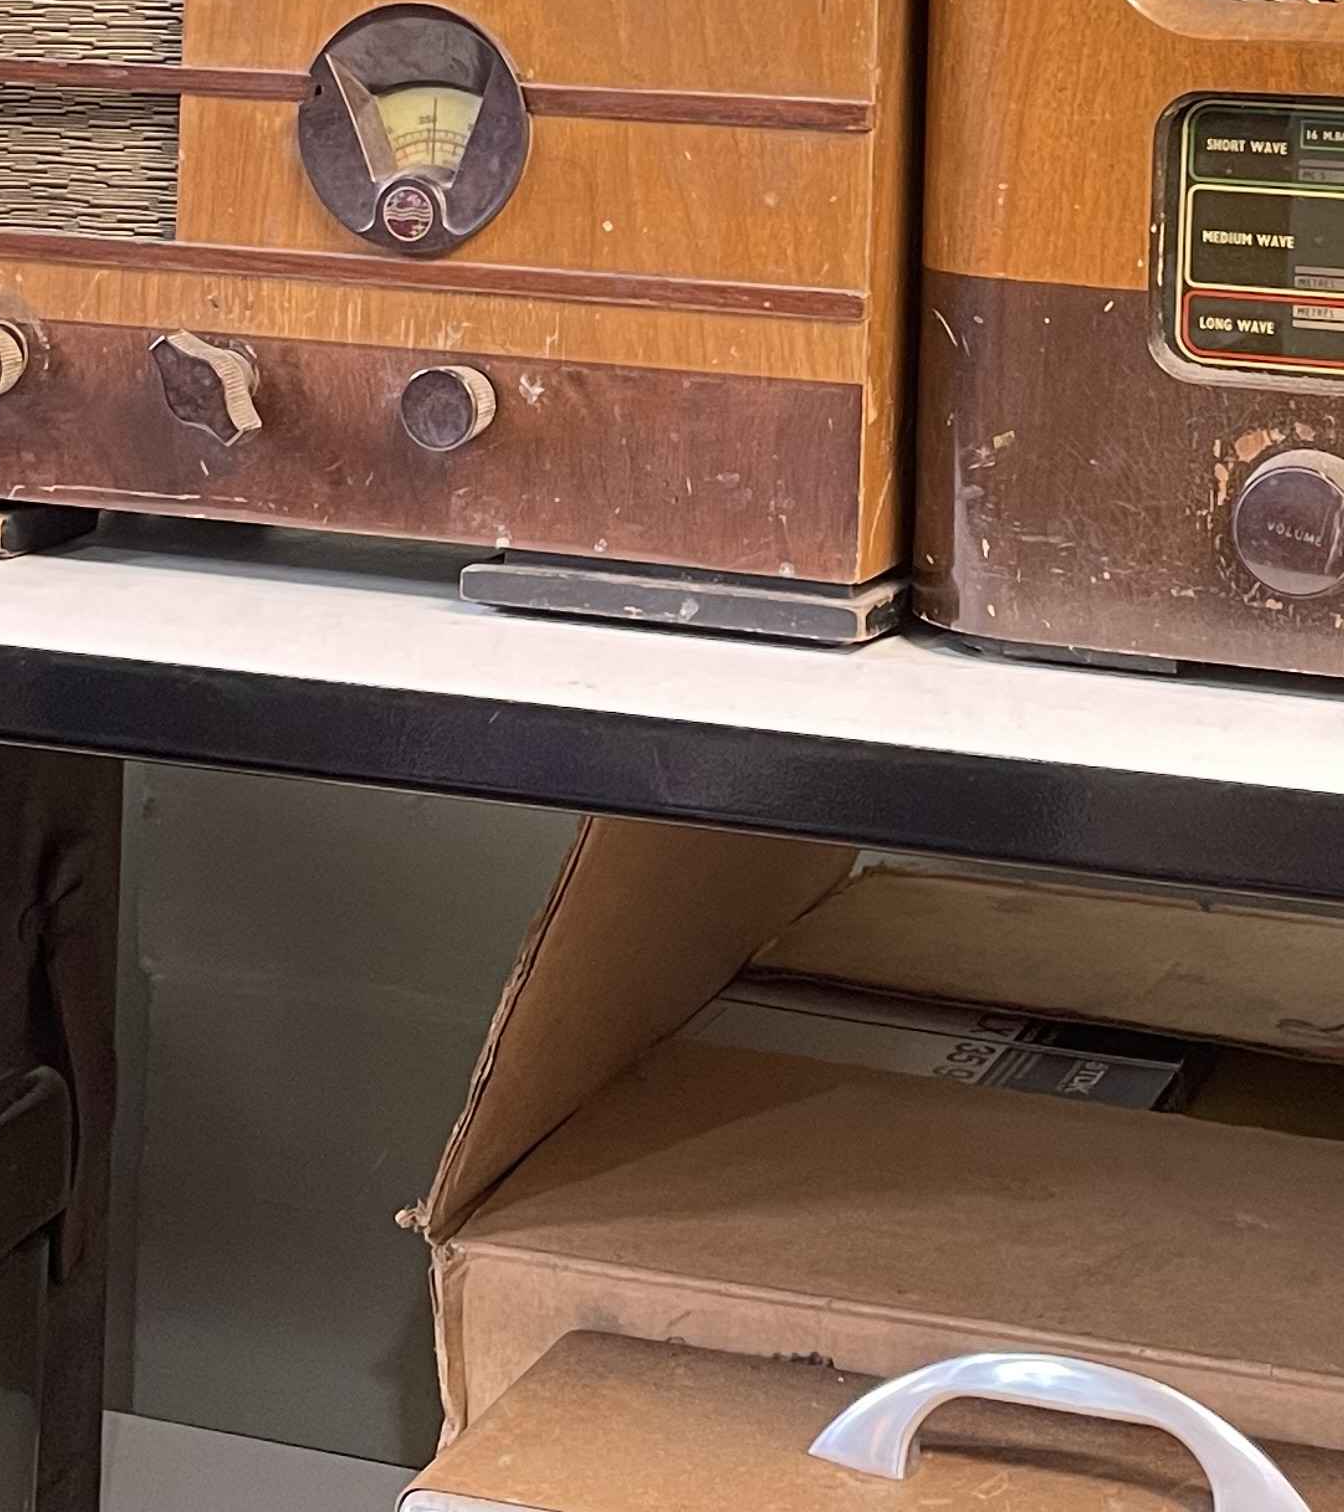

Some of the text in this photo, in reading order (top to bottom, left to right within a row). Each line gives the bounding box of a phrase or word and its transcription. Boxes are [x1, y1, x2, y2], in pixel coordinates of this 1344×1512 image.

[1306, 129, 1318, 141] 16
[1206, 138, 1288, 156] SHORT WAVE
[1202, 230, 1296, 249] MEDIUM WAVE
[1199, 316, 1275, 335] LONG WAVE
[1267, 521, 1322, 548] VOLUME
